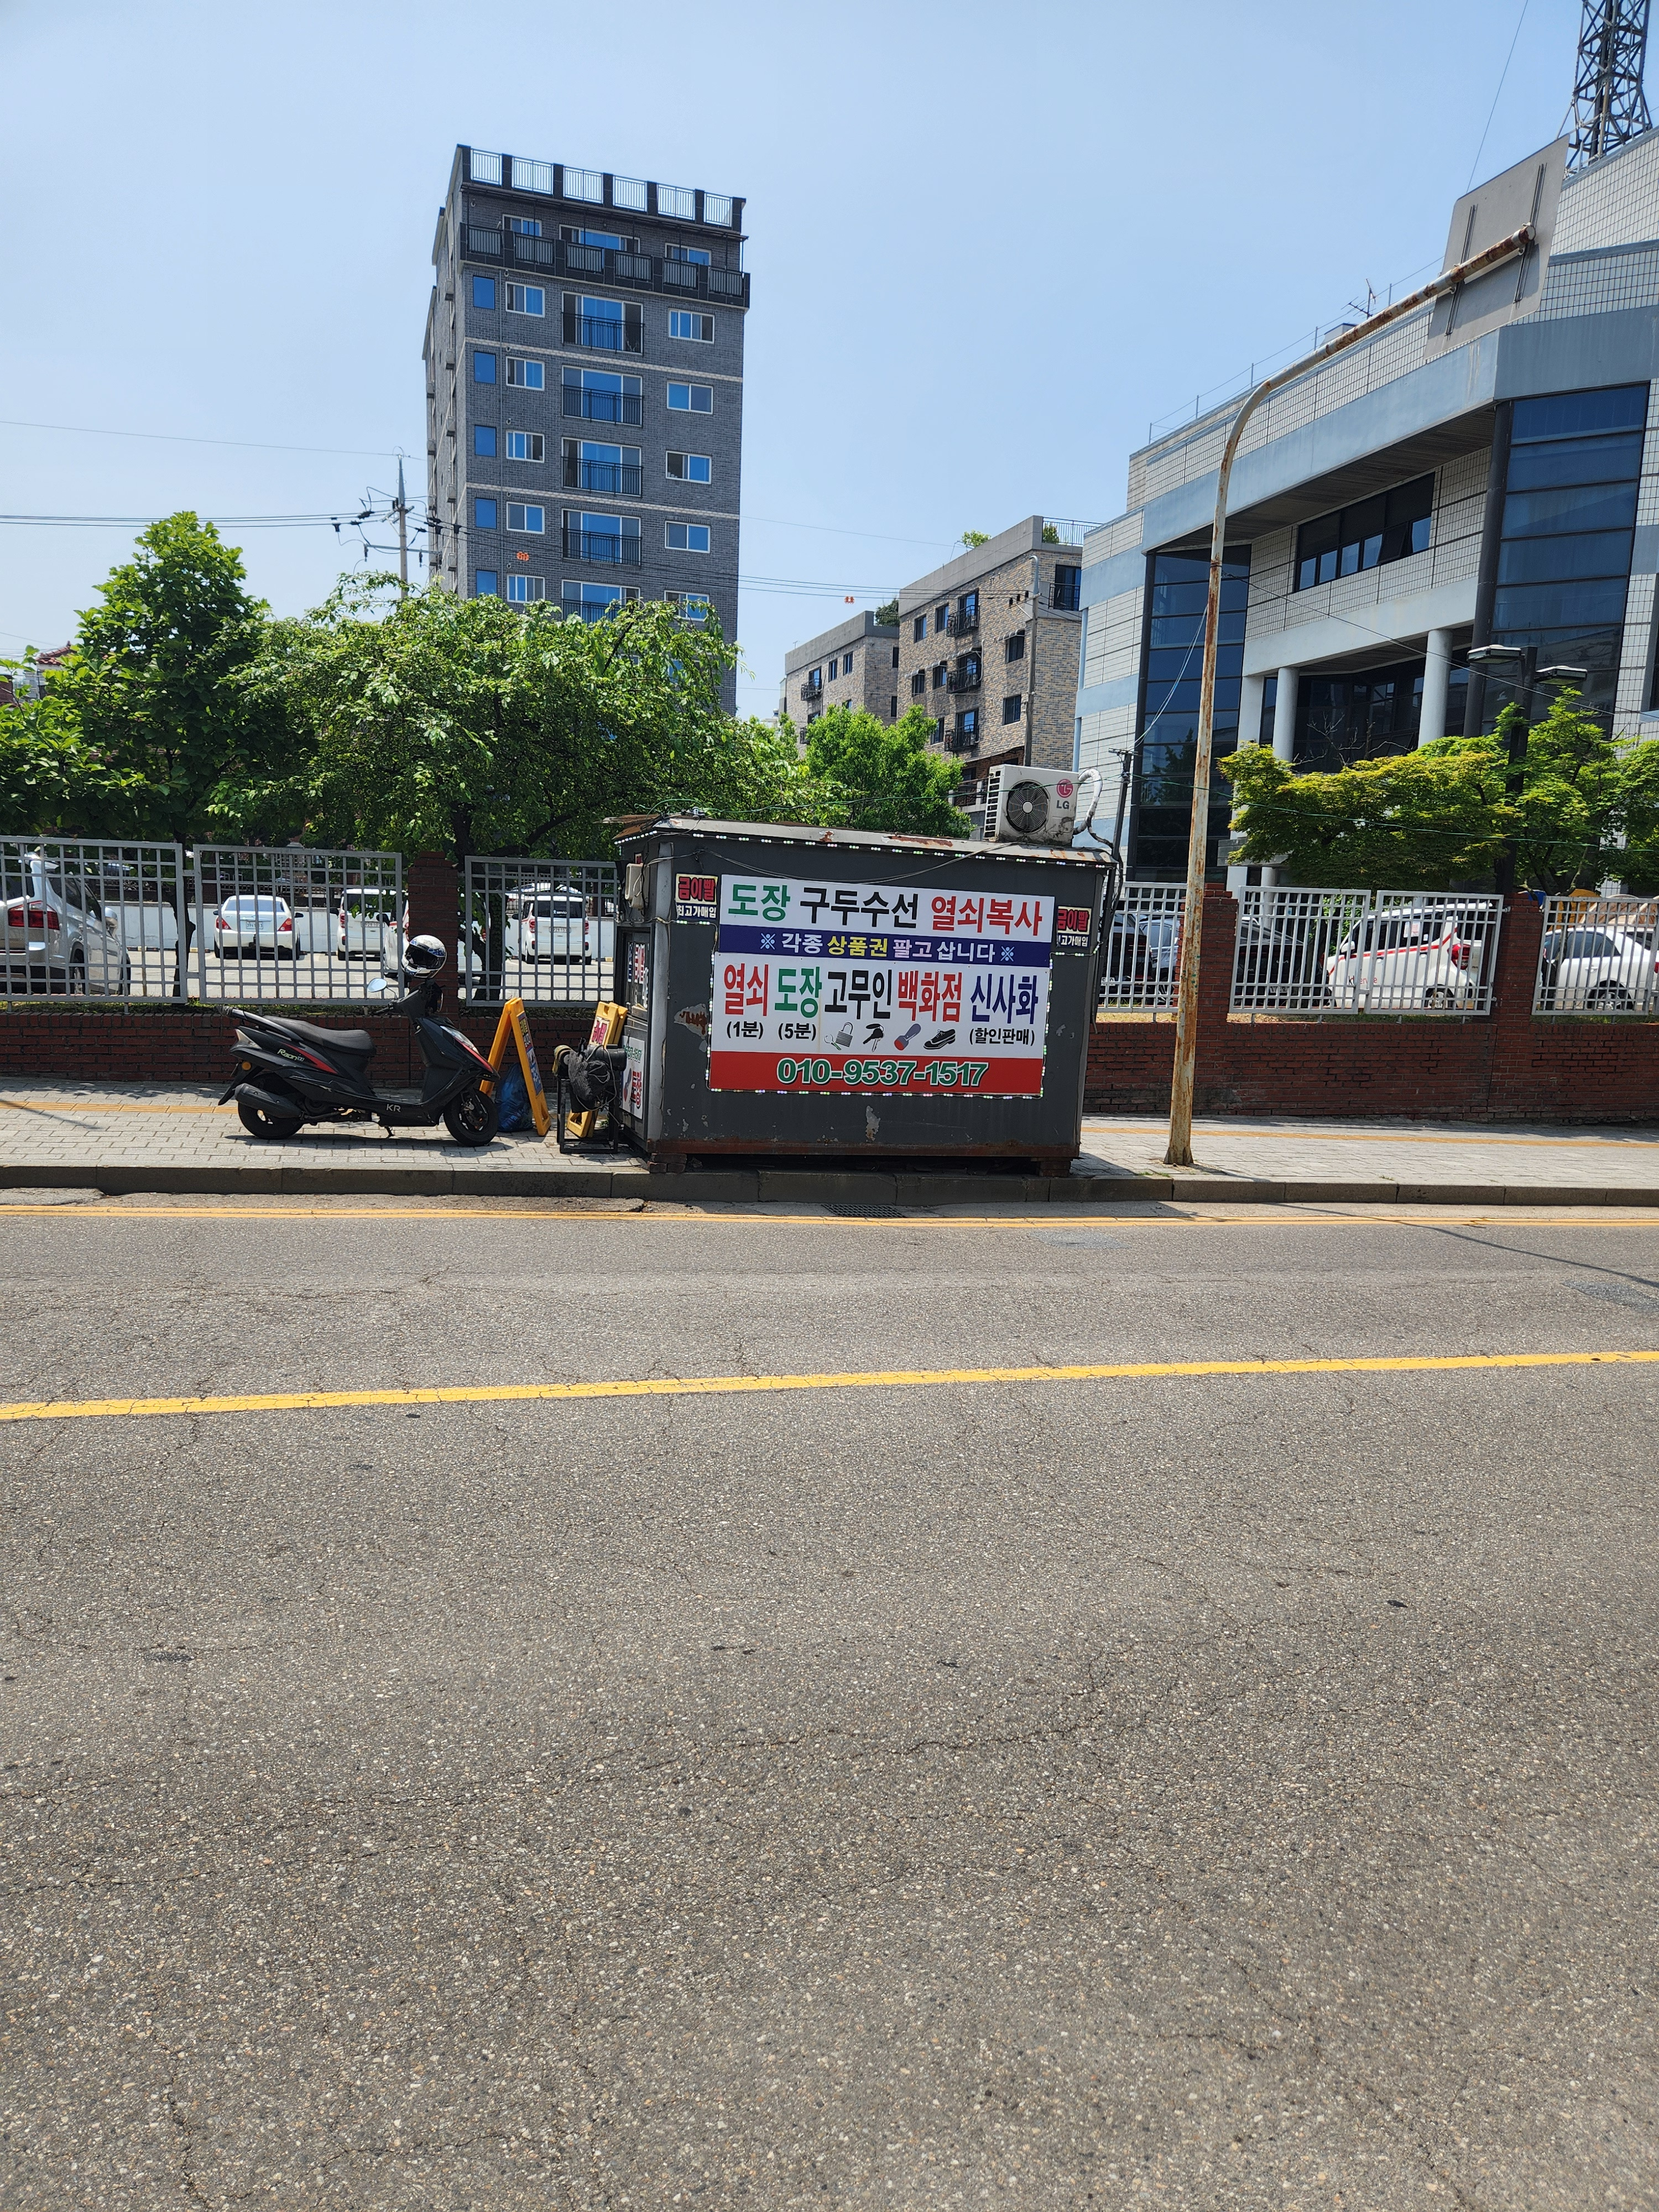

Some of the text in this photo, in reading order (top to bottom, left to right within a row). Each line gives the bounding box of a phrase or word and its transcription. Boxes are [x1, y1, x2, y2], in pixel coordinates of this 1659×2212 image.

[1056, 800, 1070, 810] LG
[678, 876, 716, 902] 금이빨
[728, 884, 1043, 936] 도장 구두수선 열쇠복사
[1057, 909, 1090, 932] 금이빨
[781, 933, 995, 963] 각종 상품권 팔고 삽니다
[724, 963, 1039, 1025] 열쇠 도장 고무인 백화점 신사화
[726, 1021, 1035, 1046] (1분) (5분) (할인판매)
[776, 1057, 989, 1087] 010-9537-1517
[386, 1103, 401, 1113] KR
